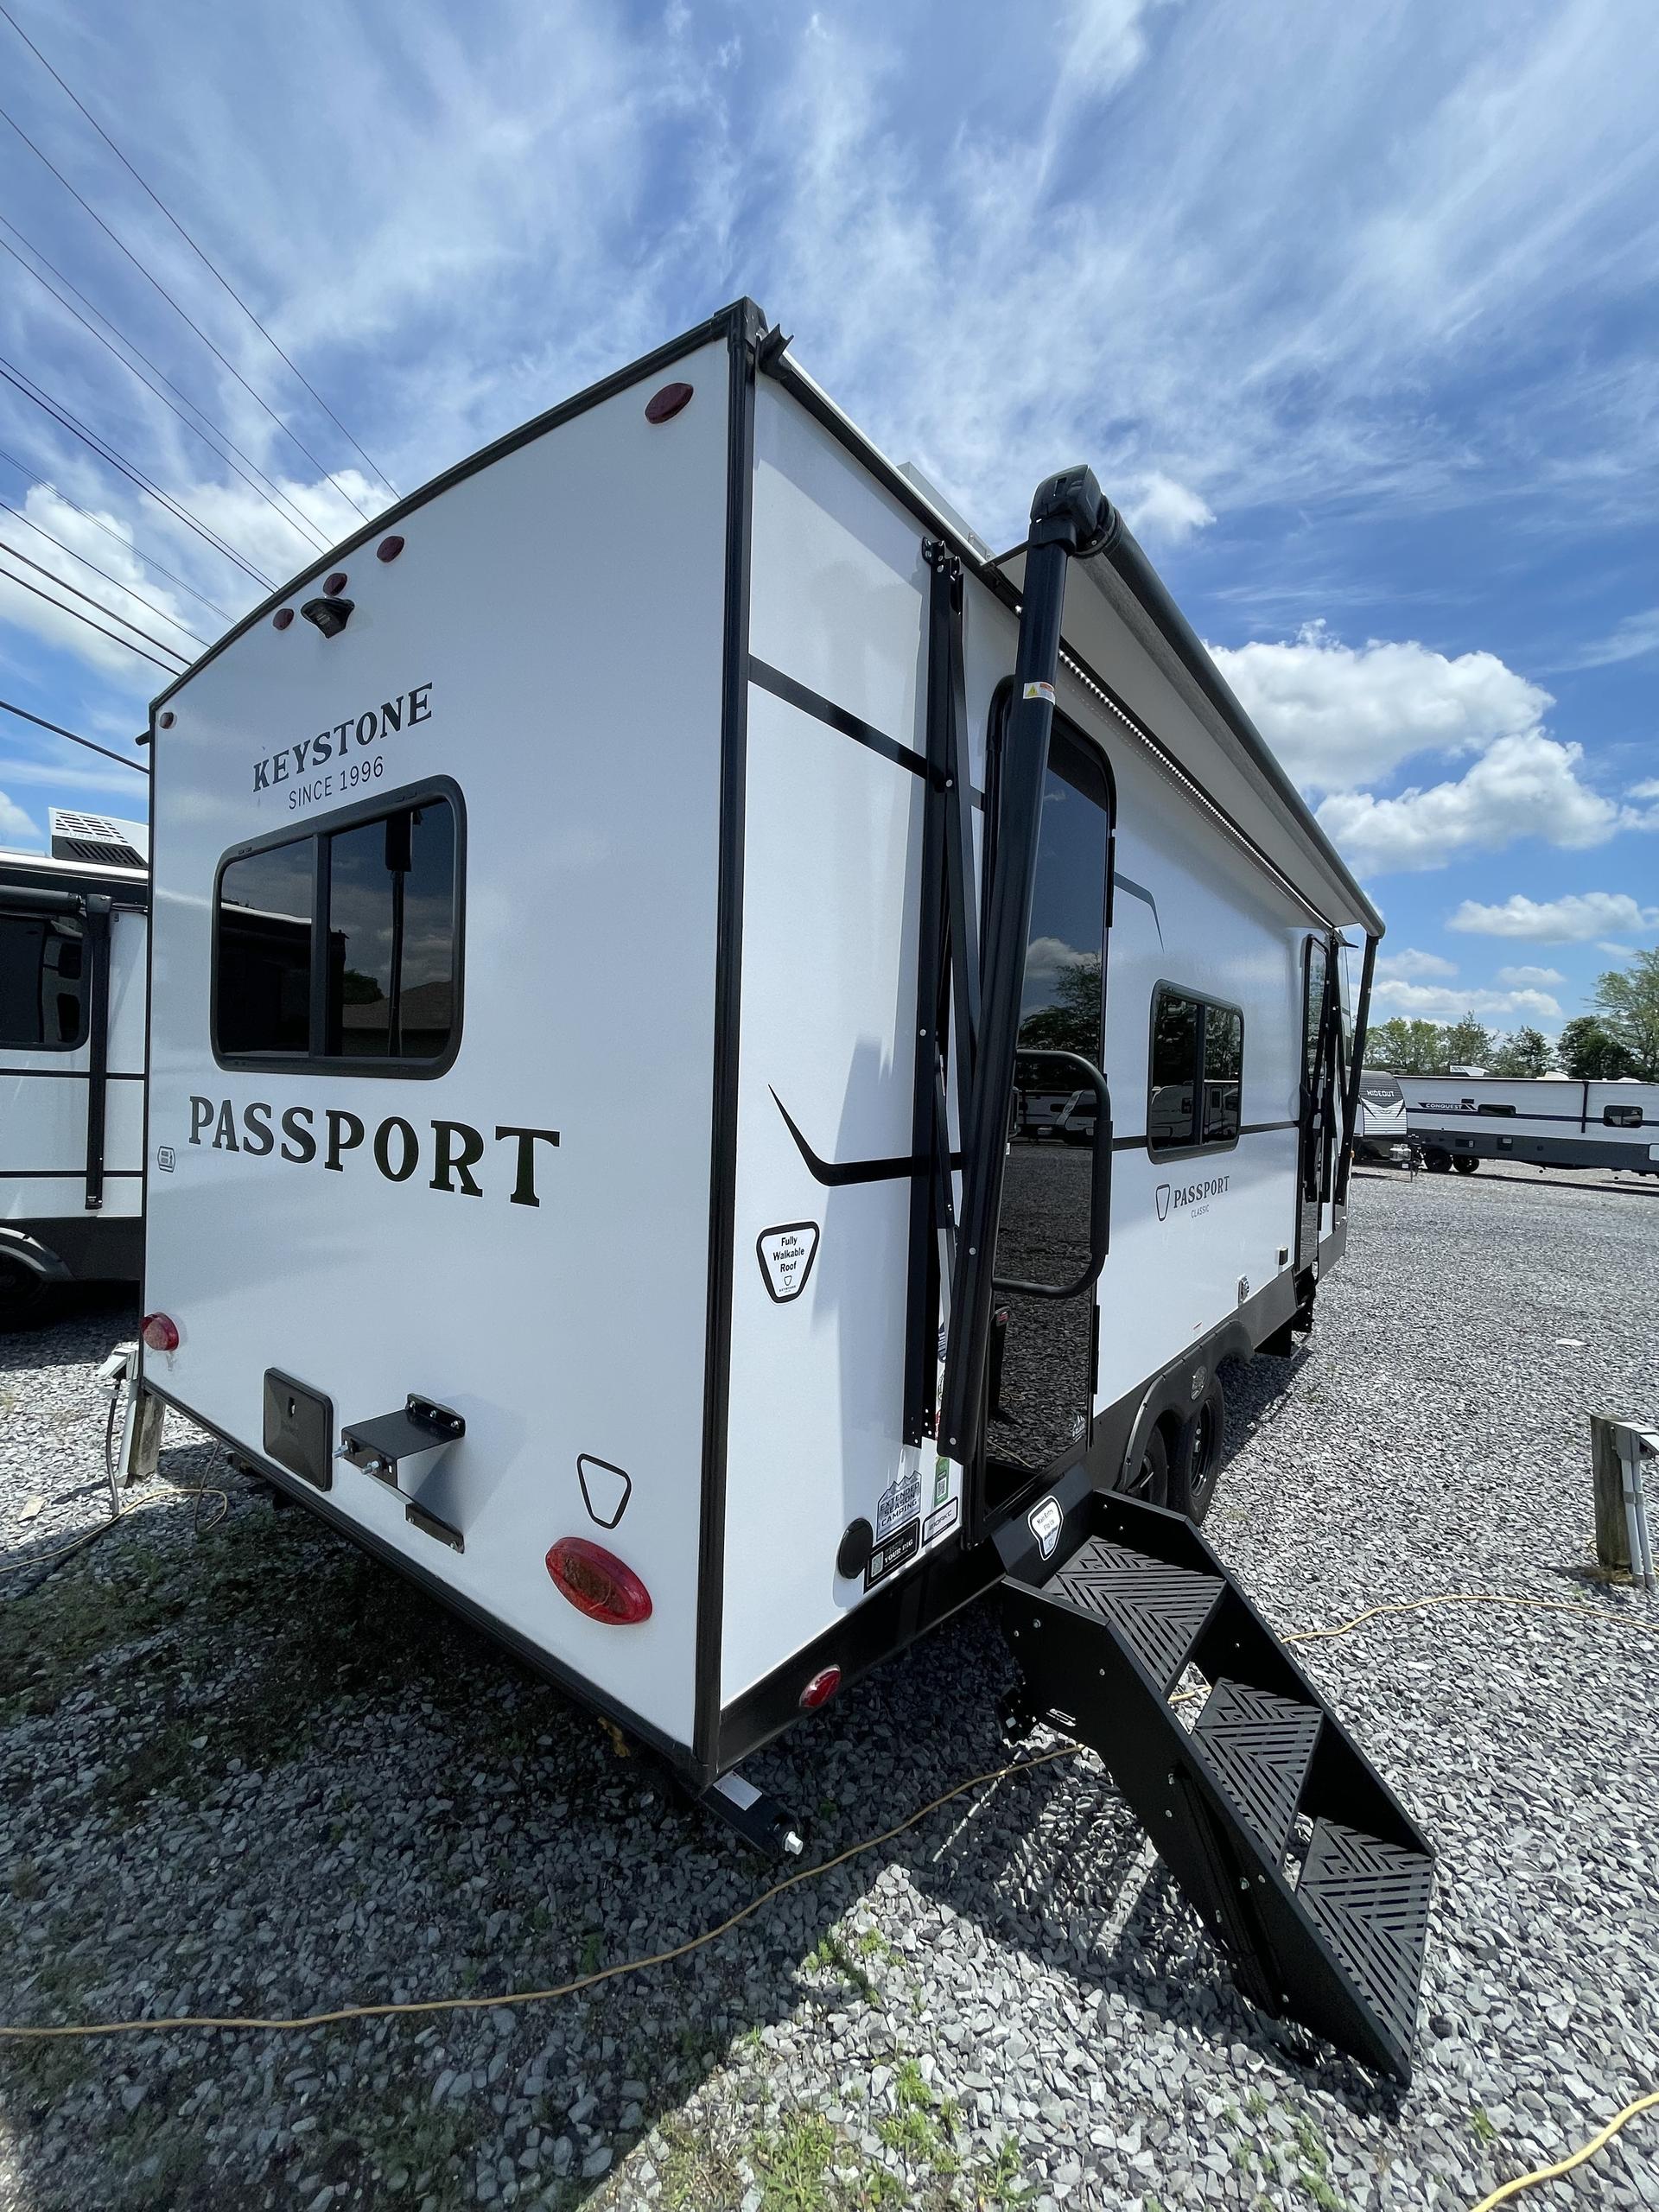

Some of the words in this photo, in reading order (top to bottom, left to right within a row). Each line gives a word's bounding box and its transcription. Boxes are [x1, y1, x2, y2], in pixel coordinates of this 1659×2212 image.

[252, 682, 432, 792] KEYSTONE
[289, 776, 333, 810] SINCE
[340, 755, 384, 791] 1996
[188, 1095, 561, 1208] PASSPORT
[1173, 1175, 1230, 1209] PASSPORT
[1191, 1205, 1210, 1218] CLASSIC
[772, 1247, 805, 1262] Walkable
[781, 1236, 798, 1247] Fully
[780, 1261, 797, 1273] Roof
[880, 1481, 920, 1512] EXTENDED
[884, 1491, 916, 1517] SEASON
[881, 1498, 918, 1527] CAMPING
[884, 1548, 902, 1564] YOUR
